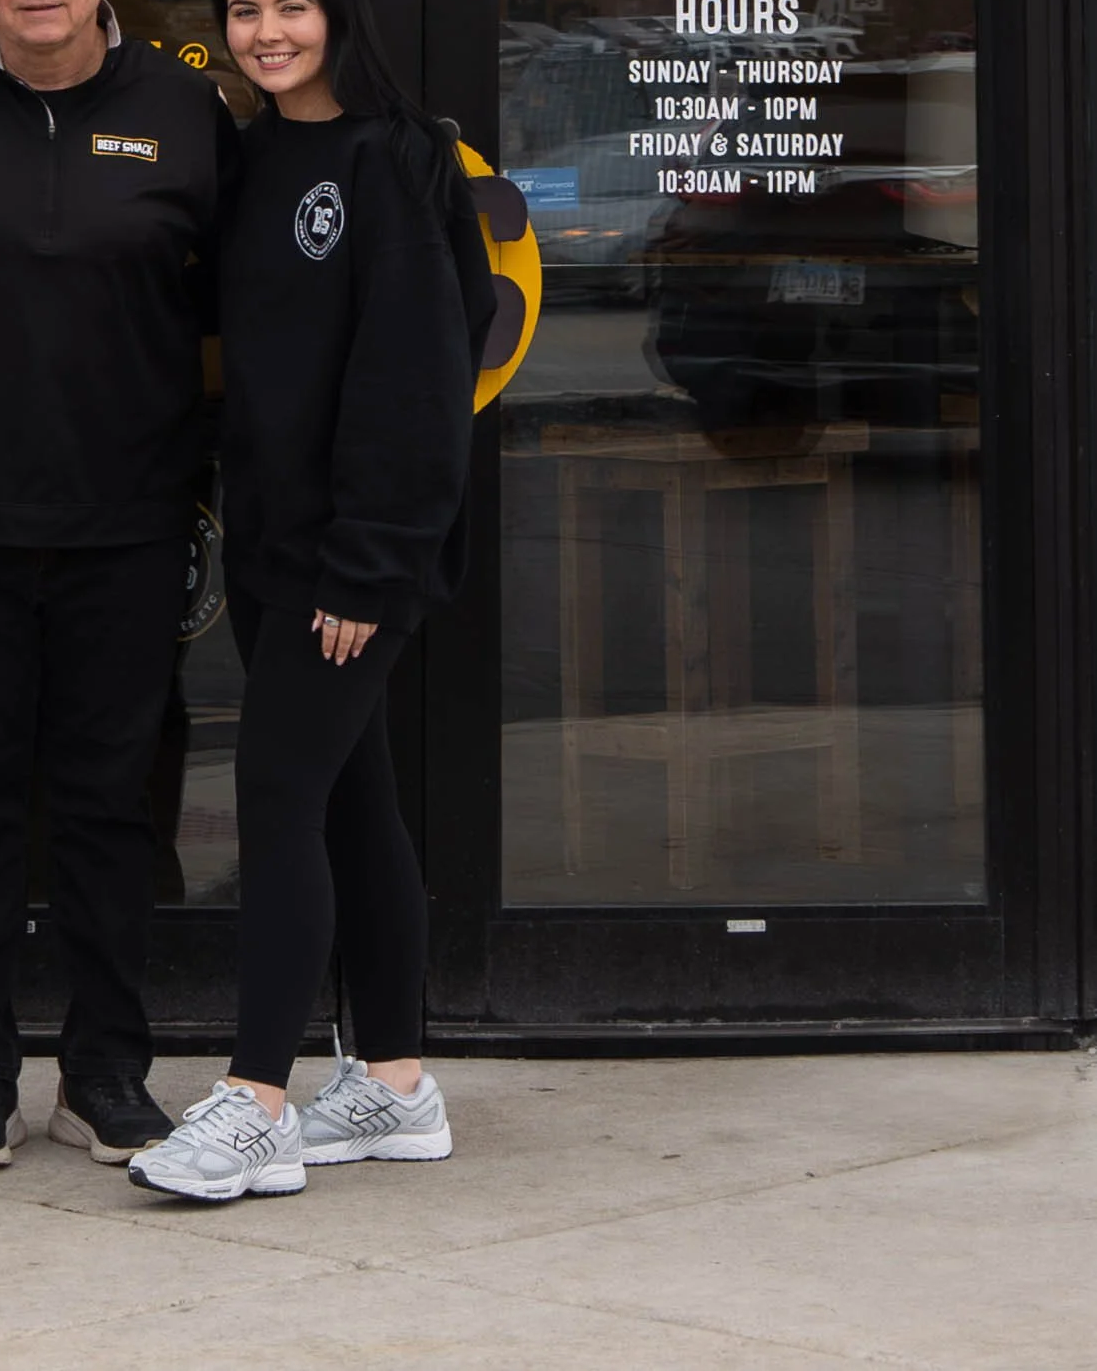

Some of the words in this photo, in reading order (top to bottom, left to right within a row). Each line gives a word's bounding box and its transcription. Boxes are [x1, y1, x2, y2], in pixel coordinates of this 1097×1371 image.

[628, 60, 711, 84] SUNDAY
[735, 60, 844, 84] THURSDAY
[654, 97, 739, 121] 10:30AM
[764, 97, 817, 121] 10PM
[97, 139, 121, 152] BEEF
[122, 142, 154, 157] SHACK
[629, 133, 702, 157] FRIDAY
[710, 133, 729, 157] &
[736, 133, 844, 157] SATURDAY
[657, 170, 741, 194] 10:30AM
[767, 170, 816, 194] 11PM
